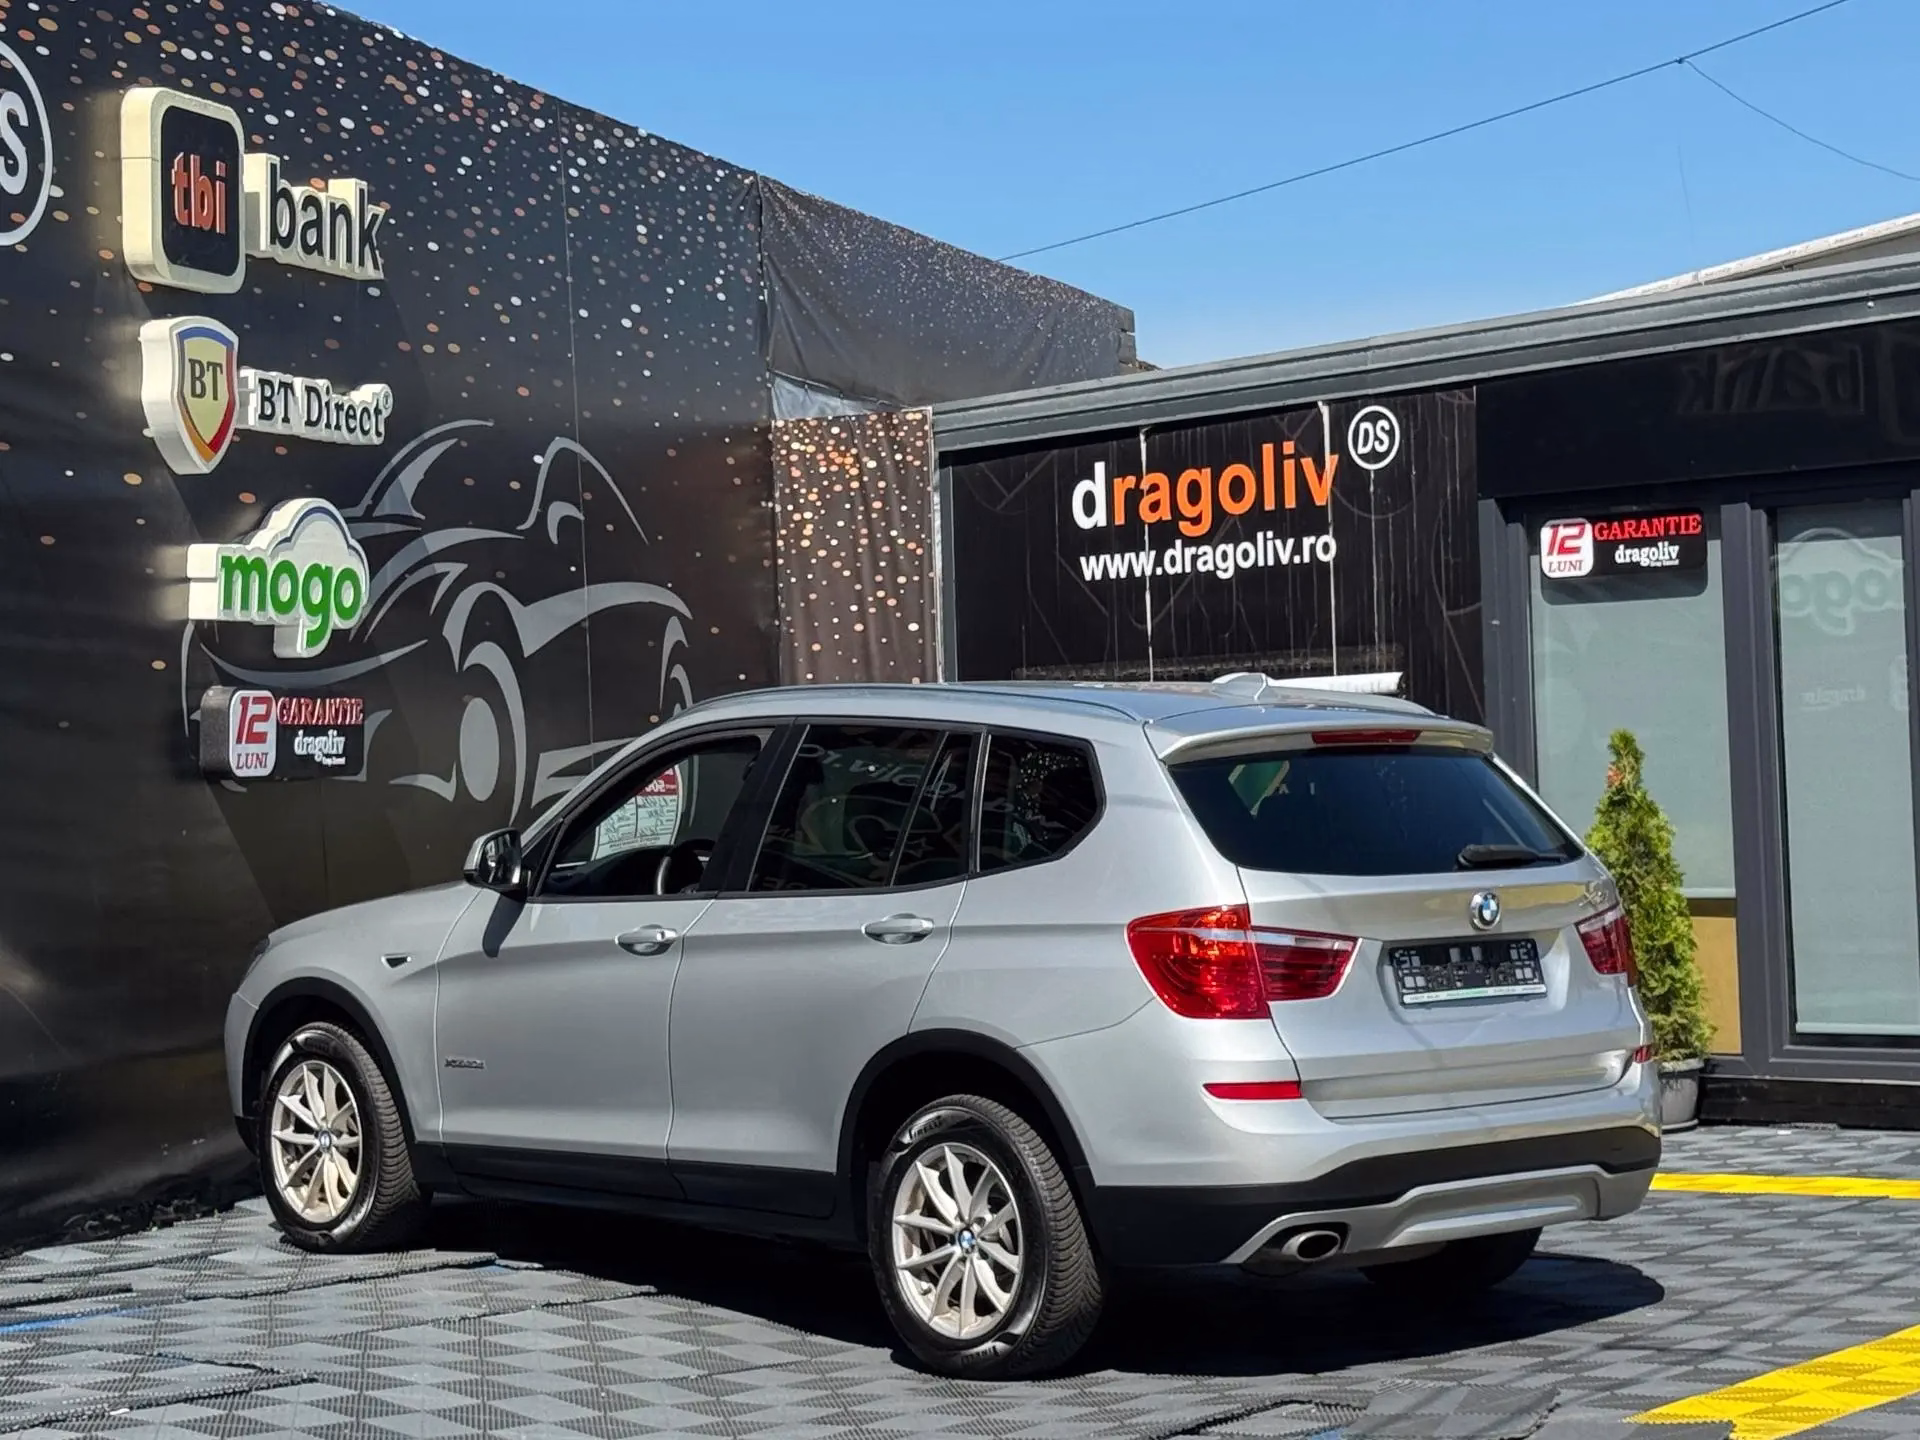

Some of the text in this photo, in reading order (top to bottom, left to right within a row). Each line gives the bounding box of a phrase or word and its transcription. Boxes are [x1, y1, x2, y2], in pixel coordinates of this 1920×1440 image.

[171, 152, 388, 271] tbi bank
[188, 358, 224, 401] BT
[258, 378, 295, 424] BT
[1357, 419, 1390, 455] DS
[1072, 440, 1339, 537] dragoliv
[1080, 531, 1337, 581] www.dragoliv.ro
[1547, 514, 1703, 557] 12 GARANTIE
[1614, 541, 1680, 567] dragoliv
[1548, 559, 1584, 574] LUNI
[220, 554, 363, 648] mogo
[235, 695, 364, 745] 12 GARANTIE
[236, 752, 269, 770] LUNI
[294, 729, 346, 762] dragoliv
